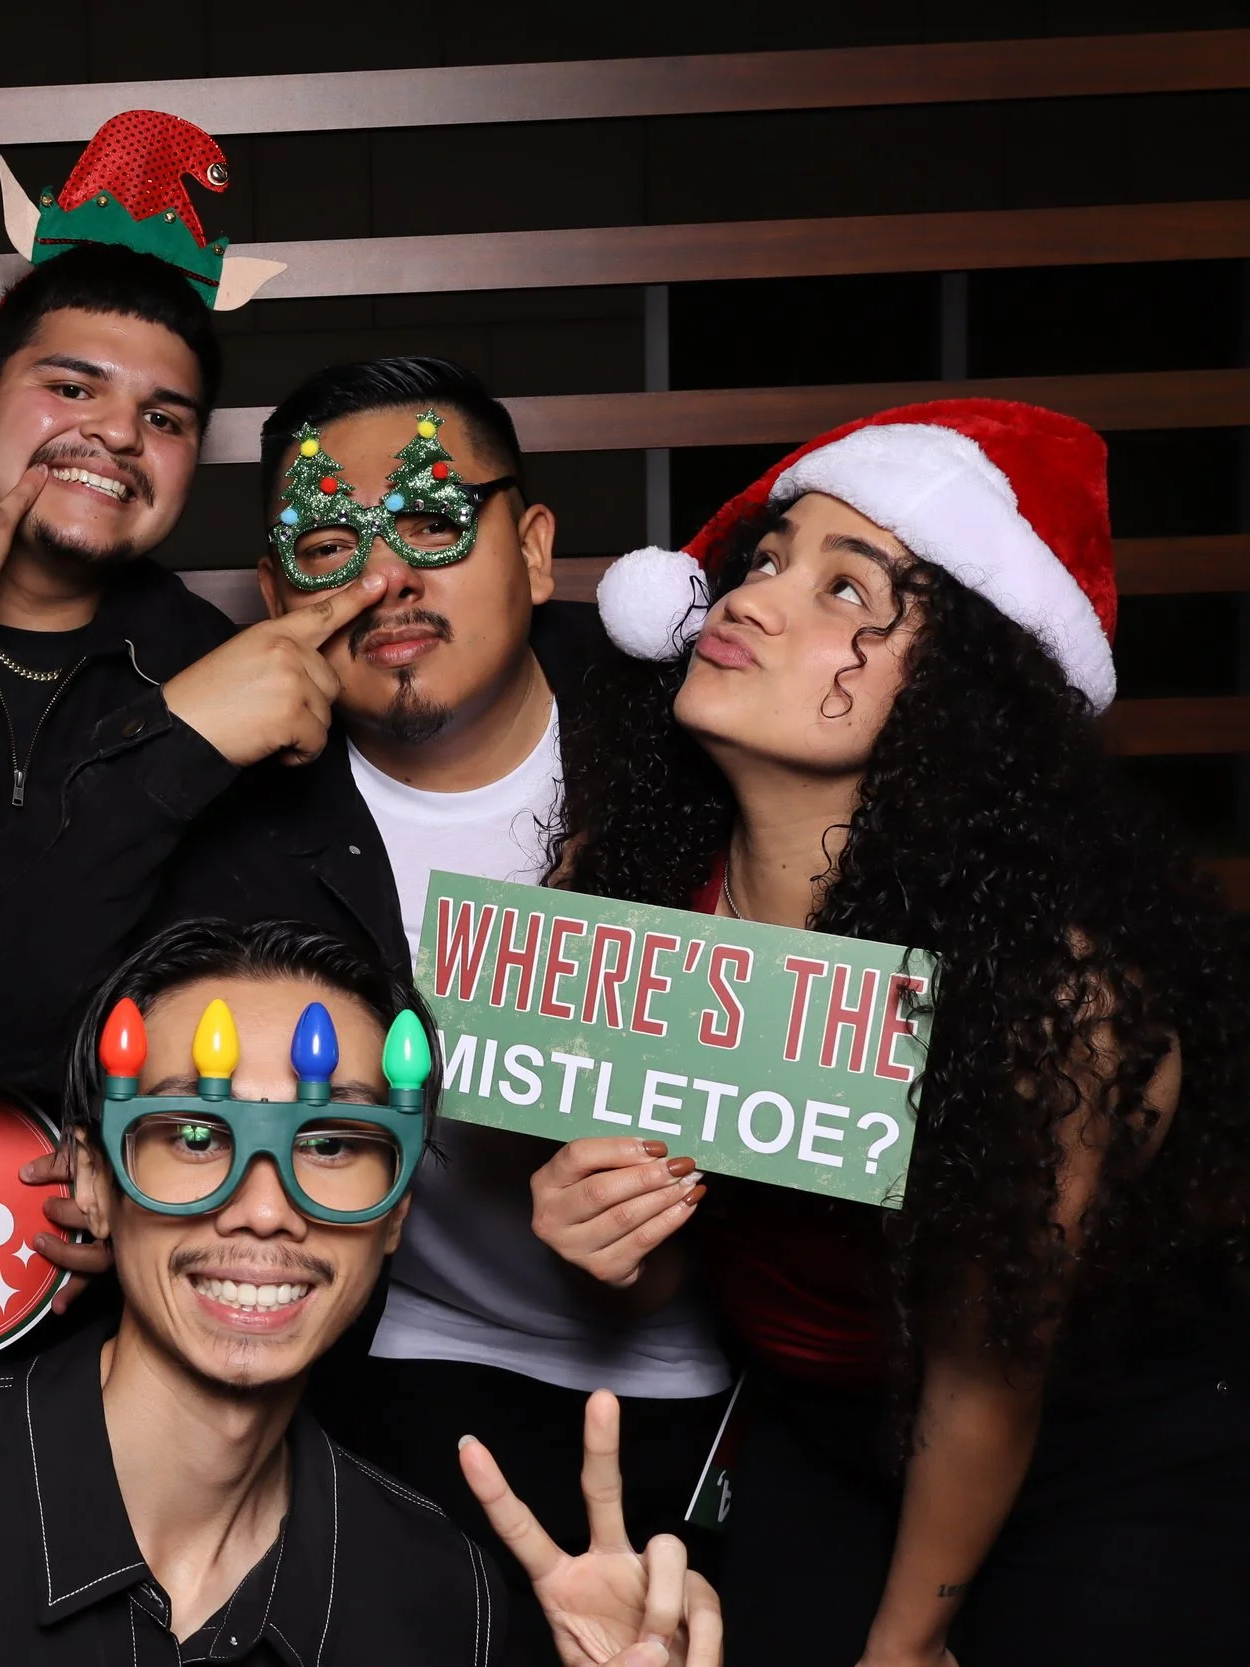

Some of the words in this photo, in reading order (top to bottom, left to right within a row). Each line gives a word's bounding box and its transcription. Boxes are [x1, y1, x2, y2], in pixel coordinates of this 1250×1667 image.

[434, 896, 754, 1050] WHERE'S
[782, 955, 929, 1083] THE
[438, 1029, 900, 1175] MISTLETOE?
